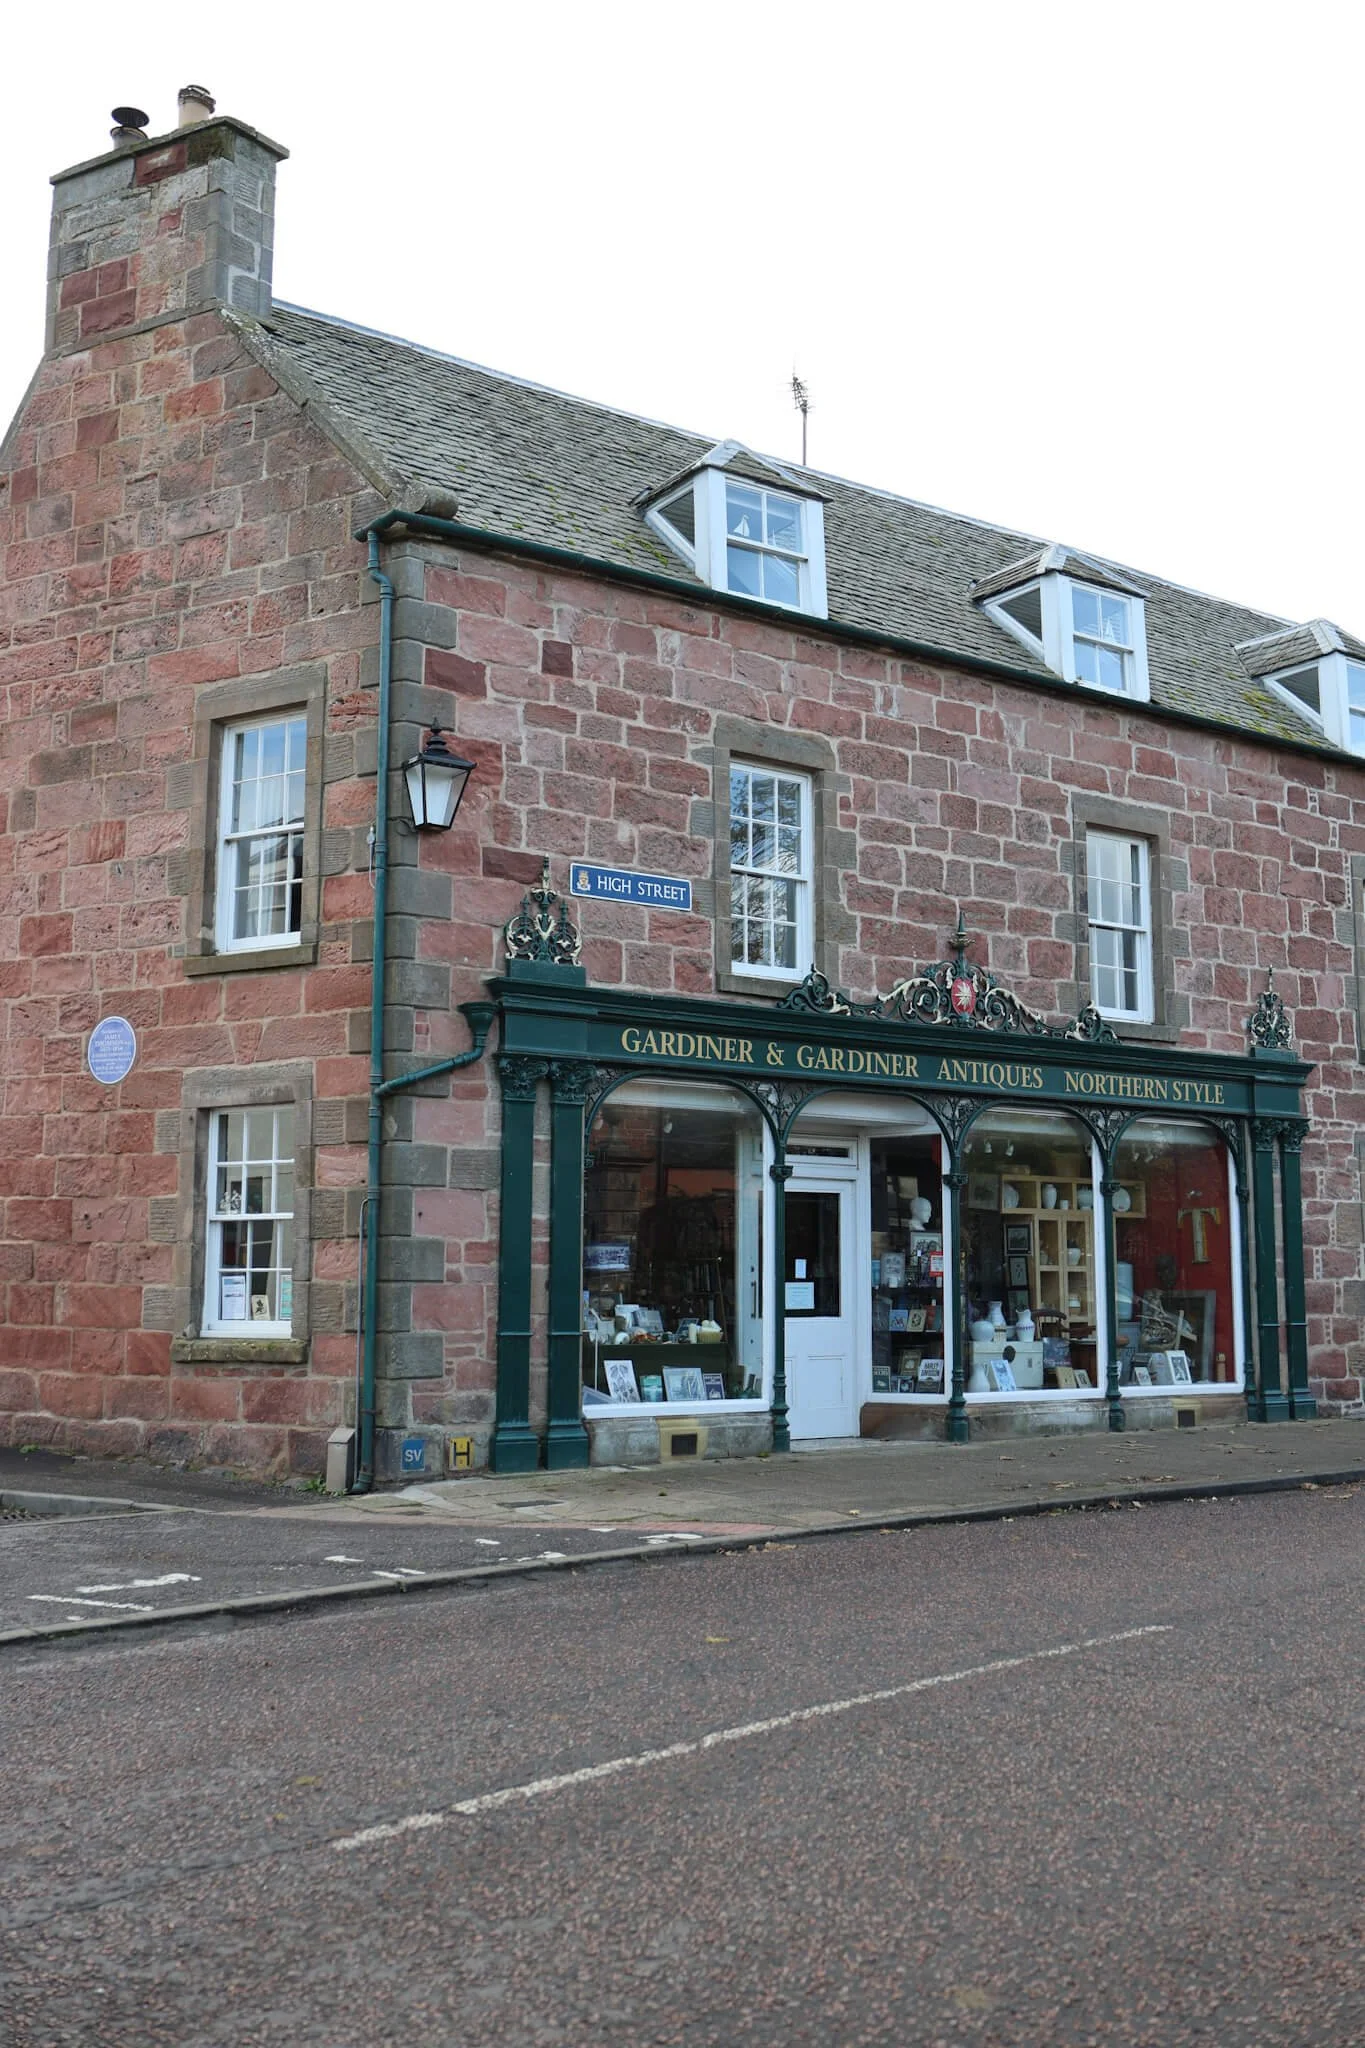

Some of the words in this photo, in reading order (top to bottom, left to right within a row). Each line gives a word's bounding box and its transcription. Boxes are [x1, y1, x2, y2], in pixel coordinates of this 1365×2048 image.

[597, 876, 632, 894] HIGH
[637, 881, 687, 901] STREET
[621, 1027, 754, 1063] GARDINER
[766, 1042, 785, 1066] &
[796, 1045, 919, 1077] GARDINER
[936, 1057, 1044, 1090] ANTIQUES
[1064, 1071, 1168, 1100] NORTHERN
[1172, 1080, 1225, 1105] STYLE
[404, 1449, 422, 1462] SV
[453, 1441, 470, 1466] H
